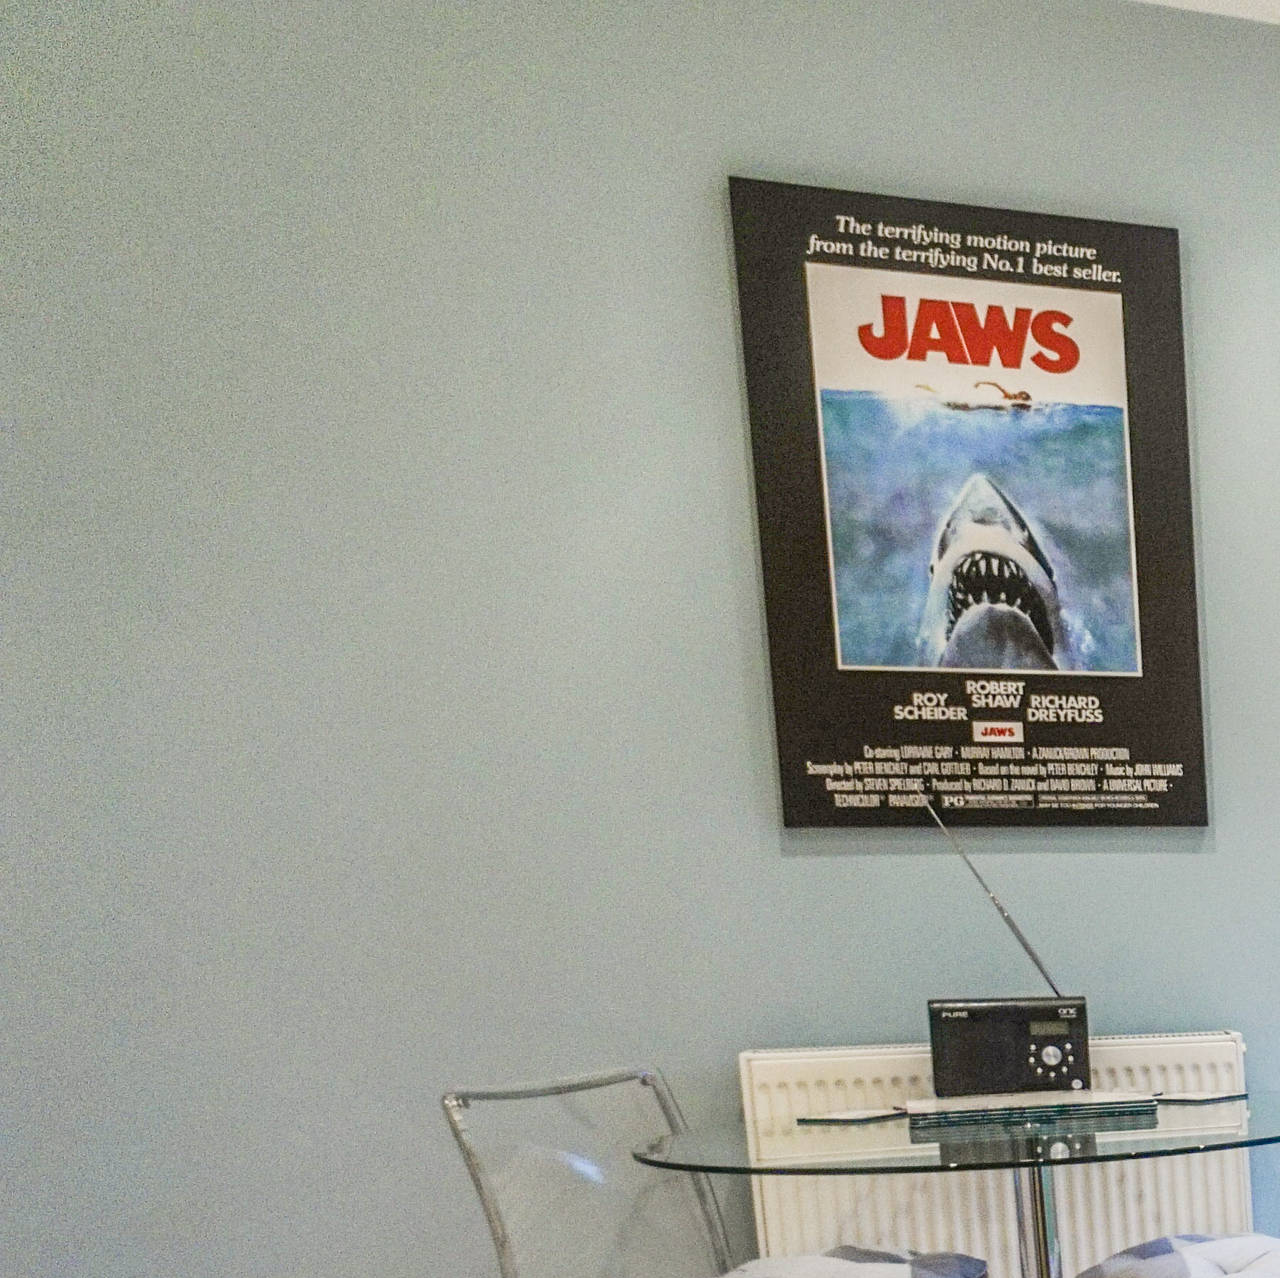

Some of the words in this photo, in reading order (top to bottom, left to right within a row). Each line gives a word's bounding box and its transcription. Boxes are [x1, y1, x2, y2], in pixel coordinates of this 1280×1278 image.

[836, 214, 873, 236] The
[877, 221, 962, 249] terrifying
[966, 234, 1031, 253] motion
[1035, 239, 1098, 260] picture
[806, 234, 854, 255] from
[859, 240, 889, 259] the
[894, 245, 978, 272] terrifying
[982, 253, 1025, 274] No.1
[1032, 258, 1069, 277] best
[1073, 264, 1122, 284] seller.
[858, 294, 1081, 374] JAWS
[966, 680, 1026, 695] ROBERT
[912, 692, 948, 706] ROY
[972, 694, 1021, 708] SHAW
[1030, 695, 1100, 710] RICHARD
[893, 706, 968, 721] SCHEIDER
[1027, 708, 1104, 723] DREYFUSS
[981, 726, 1015, 737] JAWS
[943, 795, 965, 807] PG
